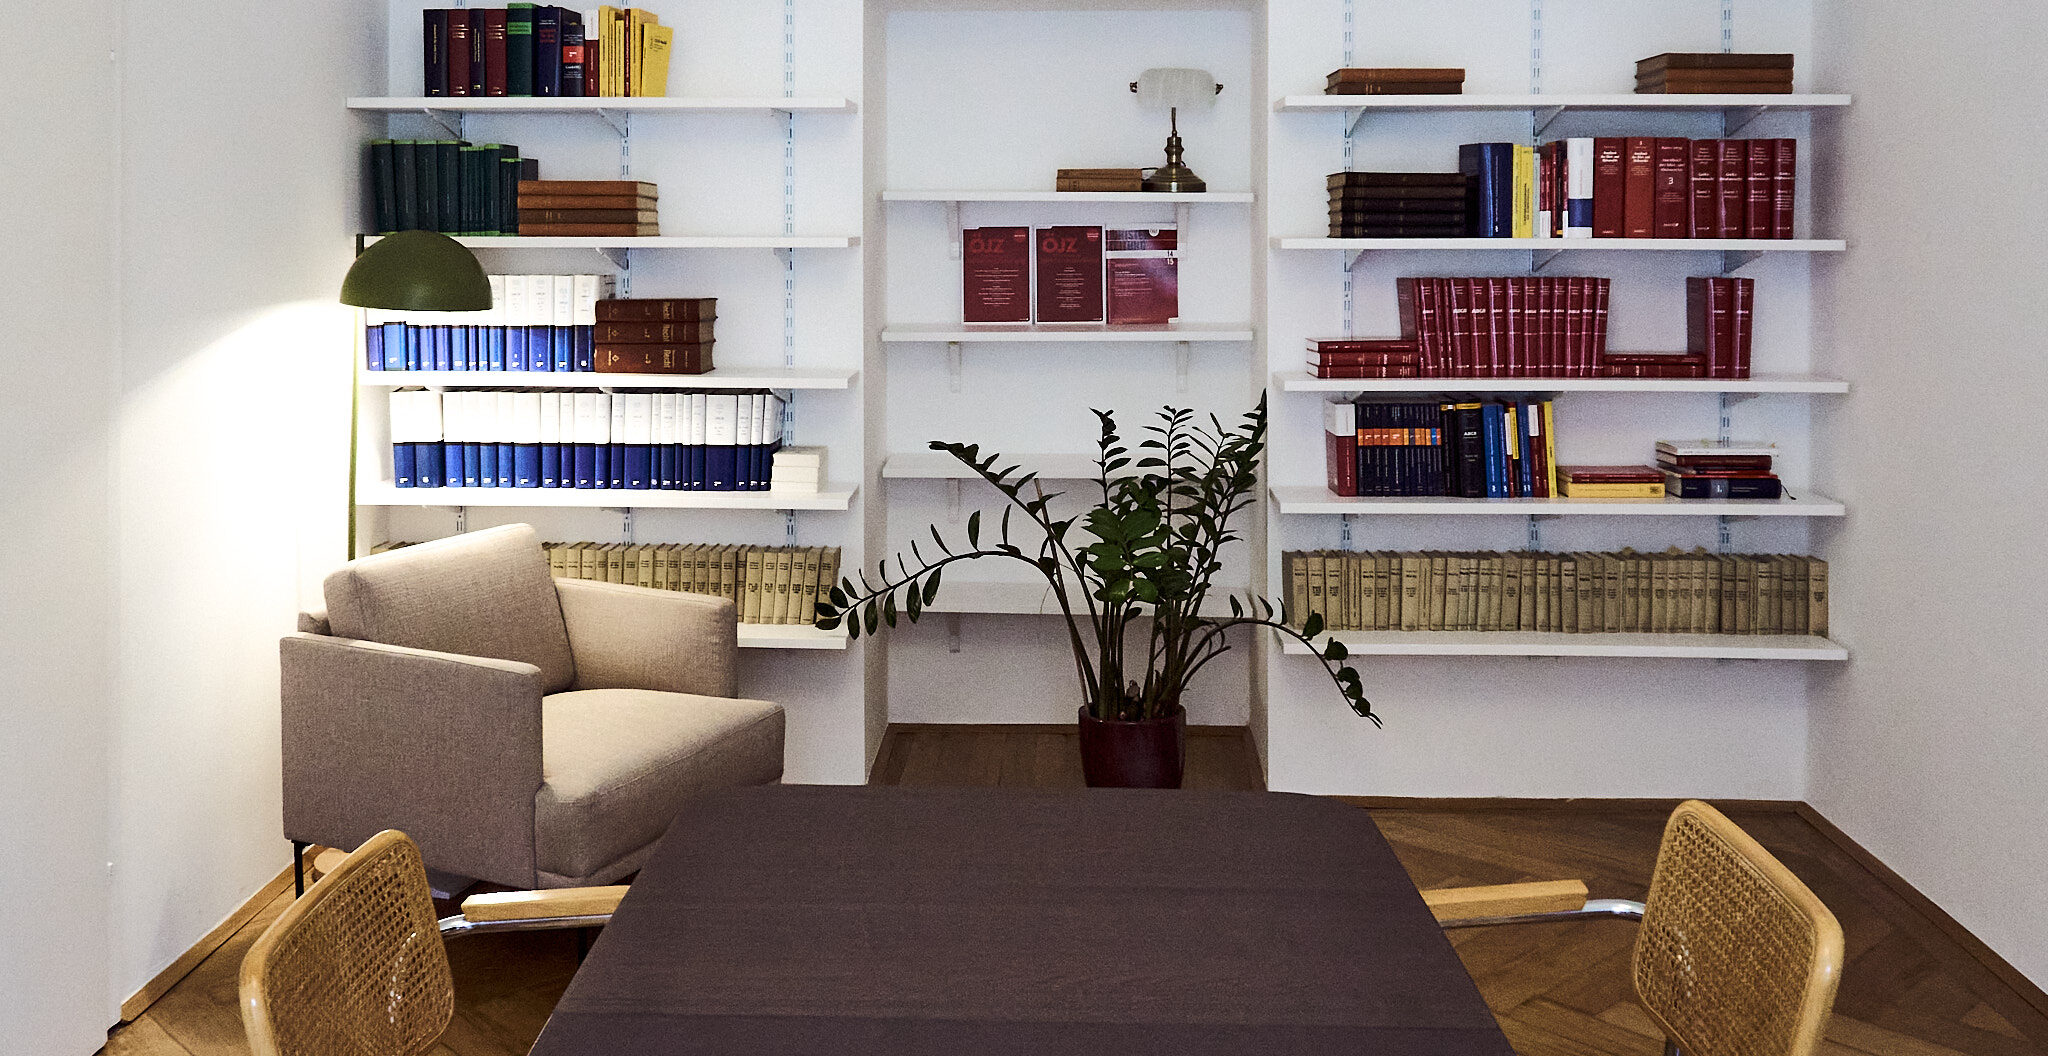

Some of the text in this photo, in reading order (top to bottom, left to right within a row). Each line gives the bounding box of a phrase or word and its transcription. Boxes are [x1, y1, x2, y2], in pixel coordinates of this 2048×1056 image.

[1668, 177, 1674, 185] 3
[968, 233, 1005, 254] ÖJZ
[1042, 231, 1078, 253] ÖJZ
